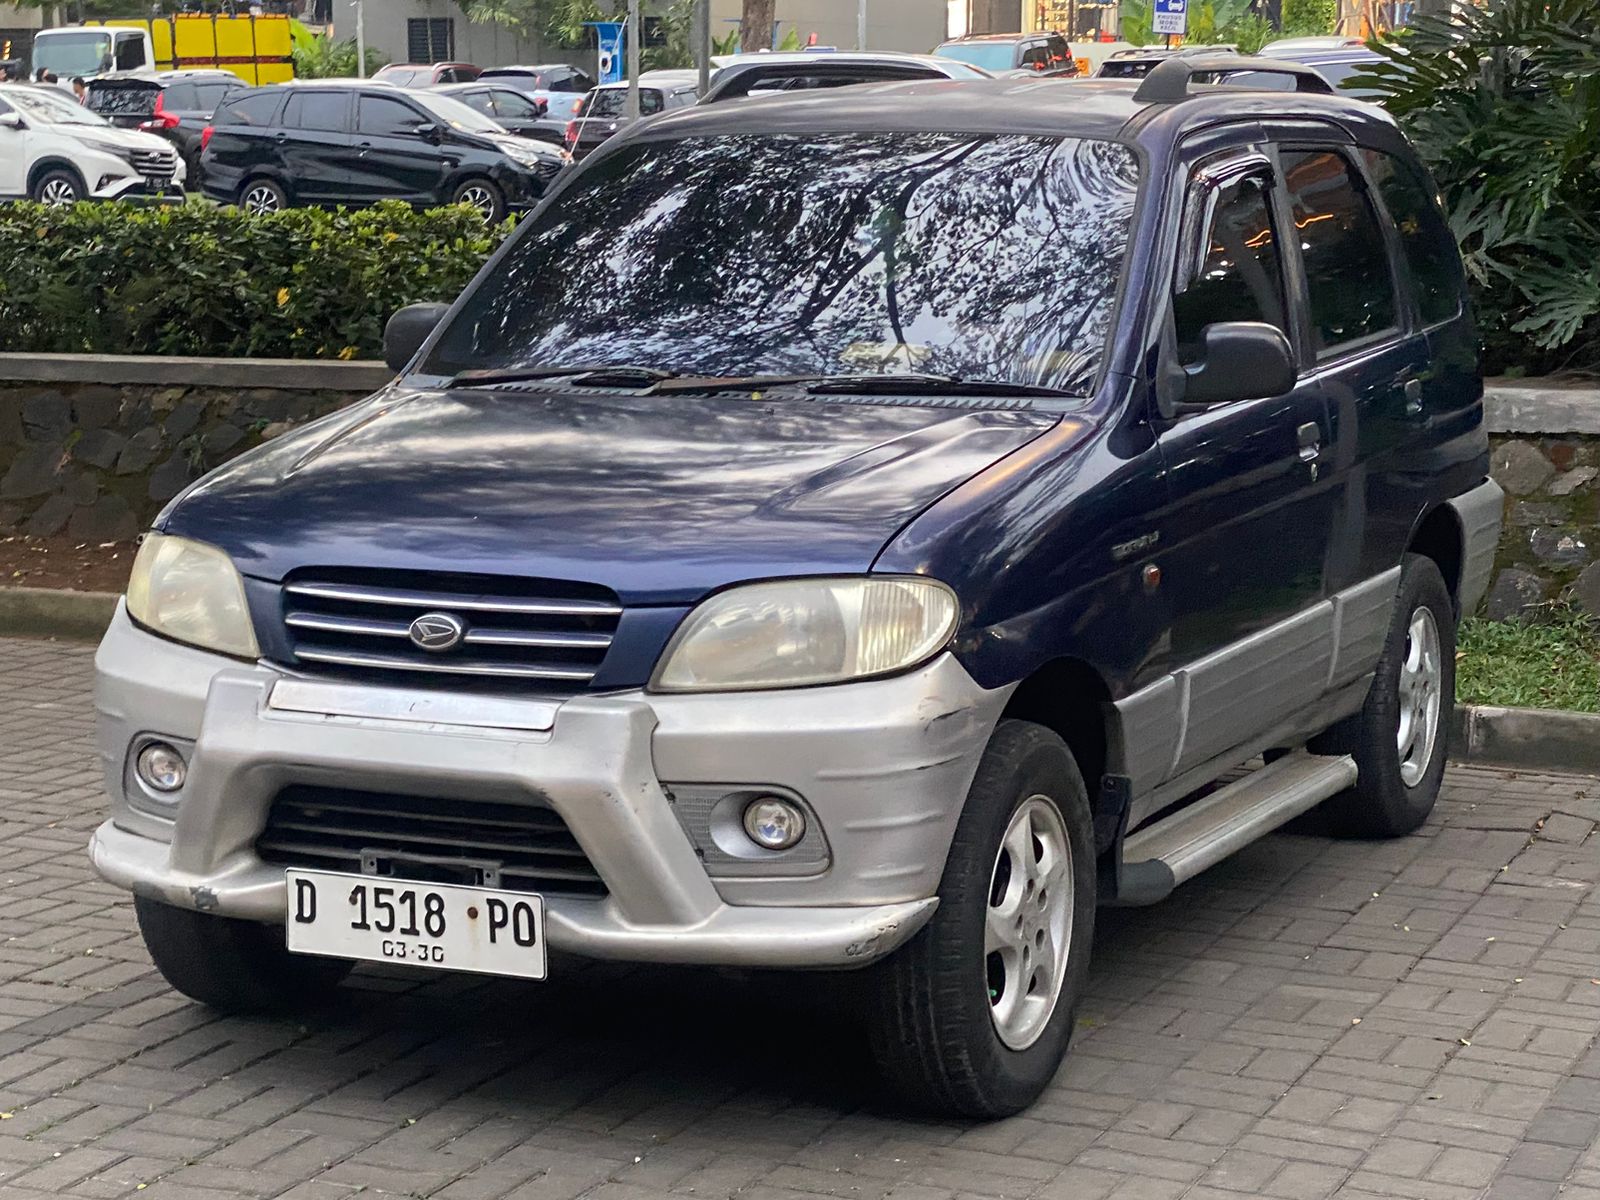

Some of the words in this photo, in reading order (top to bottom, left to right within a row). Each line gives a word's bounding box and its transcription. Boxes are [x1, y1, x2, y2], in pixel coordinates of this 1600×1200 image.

[295, 878, 317, 924] D
[349, 884, 446, 938] 1518
[486, 897, 536, 948] PO
